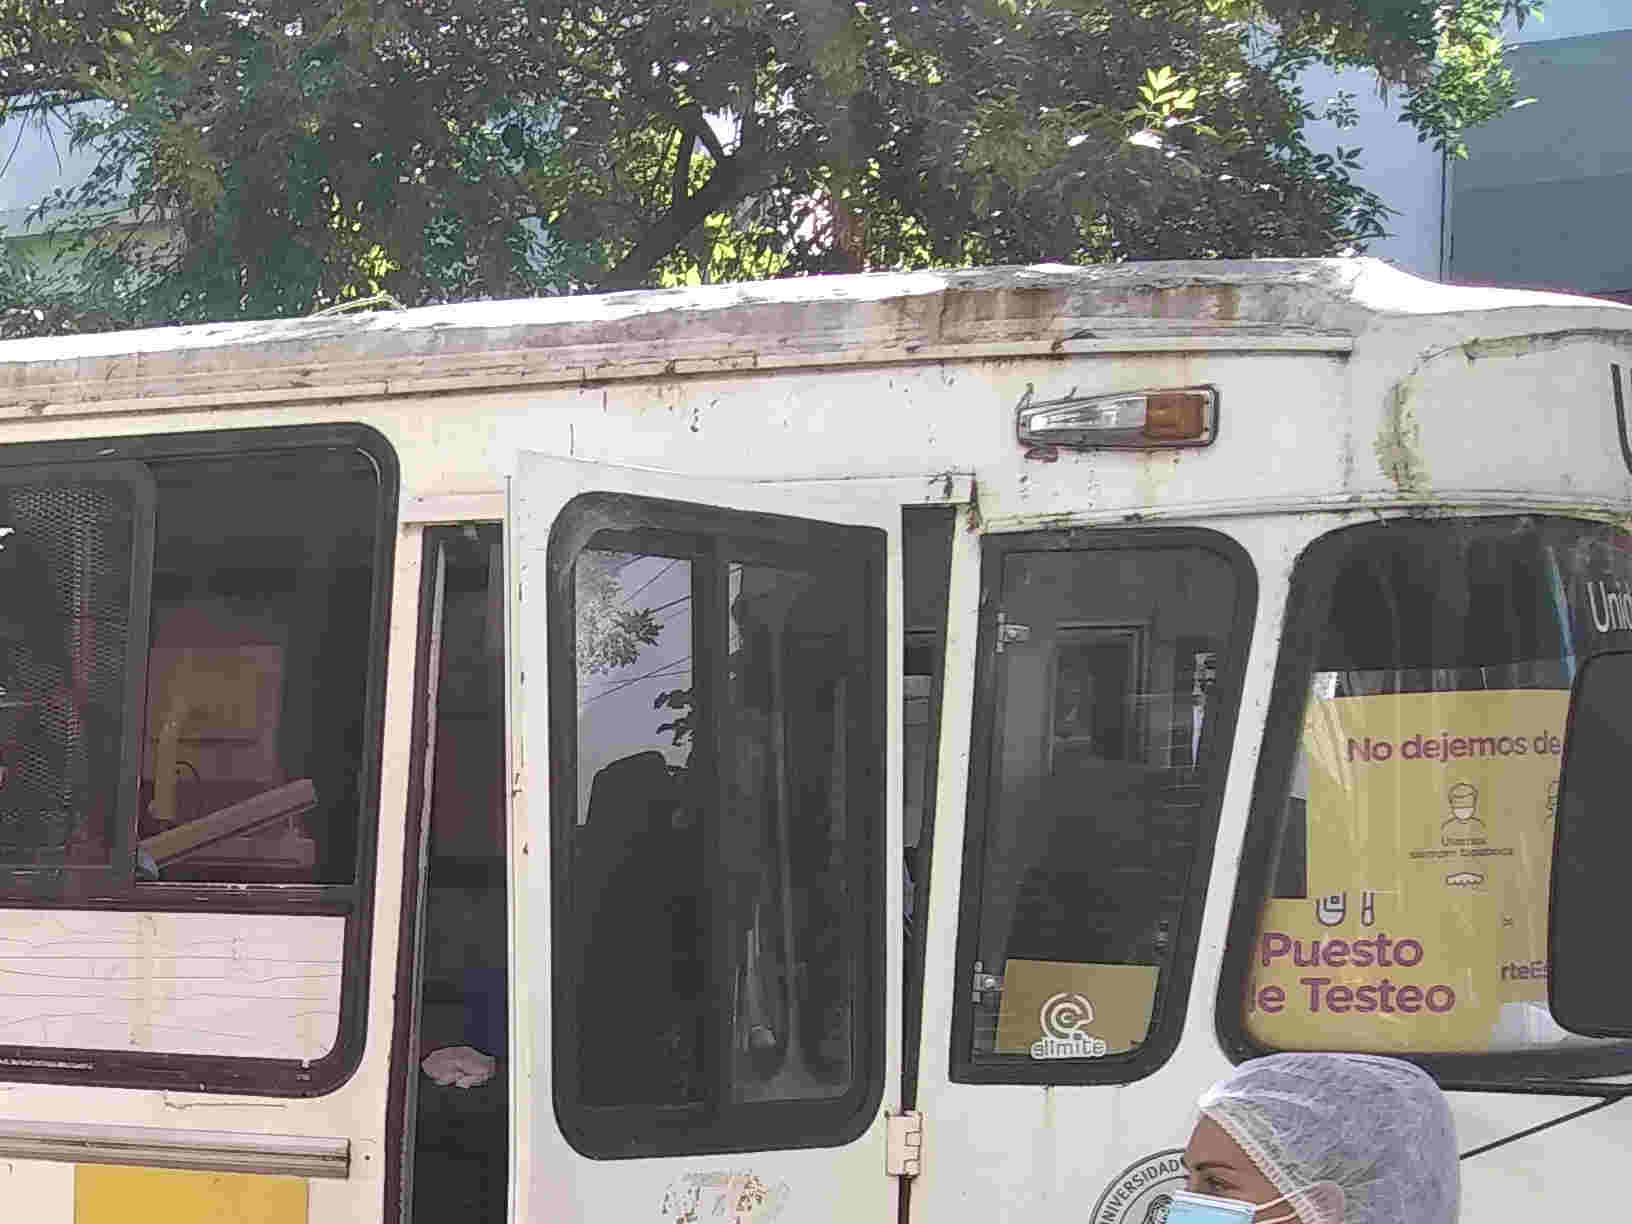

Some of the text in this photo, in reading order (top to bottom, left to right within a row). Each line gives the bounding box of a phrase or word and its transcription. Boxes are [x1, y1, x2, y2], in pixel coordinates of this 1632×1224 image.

[1347, 736, 1393, 762] No
[1400, 732, 1528, 762] dejemos
[1261, 932, 1424, 968] Puesto
[1249, 975, 1456, 1013] e Testeo
